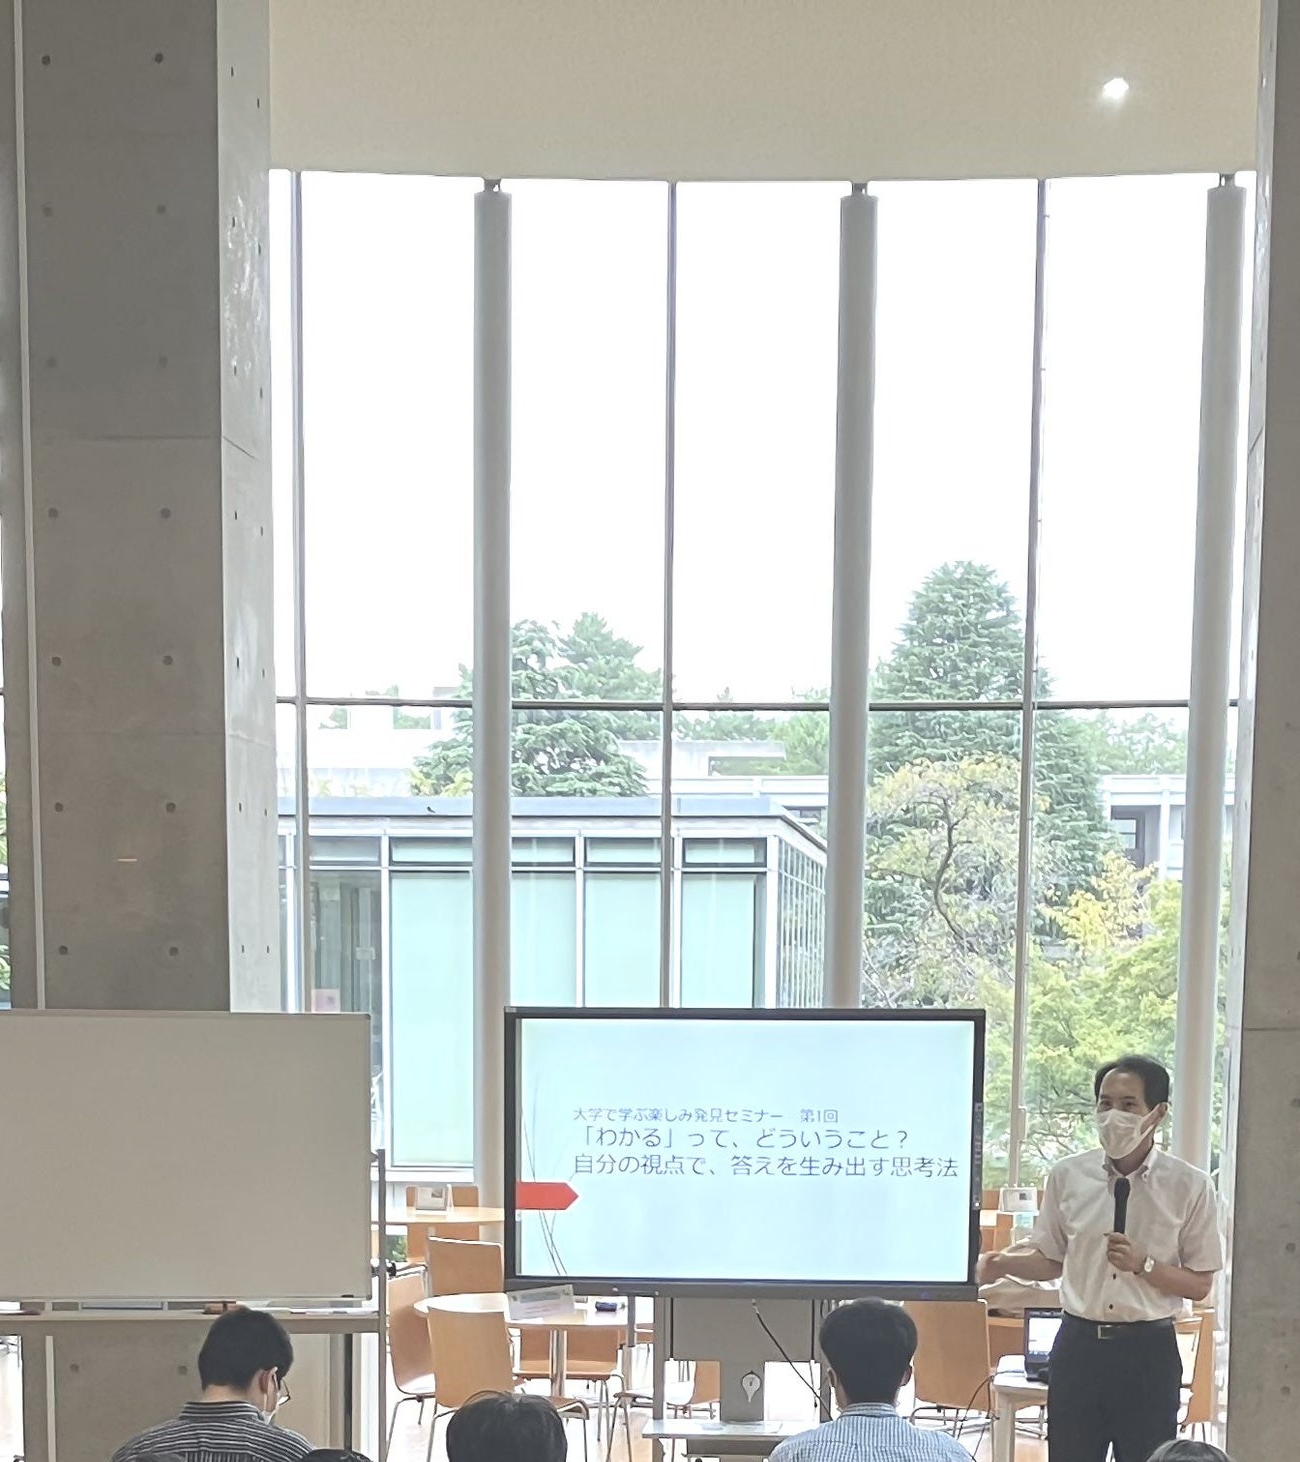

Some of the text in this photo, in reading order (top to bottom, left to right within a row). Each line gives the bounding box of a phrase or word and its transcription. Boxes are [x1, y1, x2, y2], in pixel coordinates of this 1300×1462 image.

[572, 1107, 840, 1124] 大学で学ぶ楽しみ発見セミナー 第1回
[574, 1153, 959, 1178] 自分の視点で、答えを生み出す思考法
